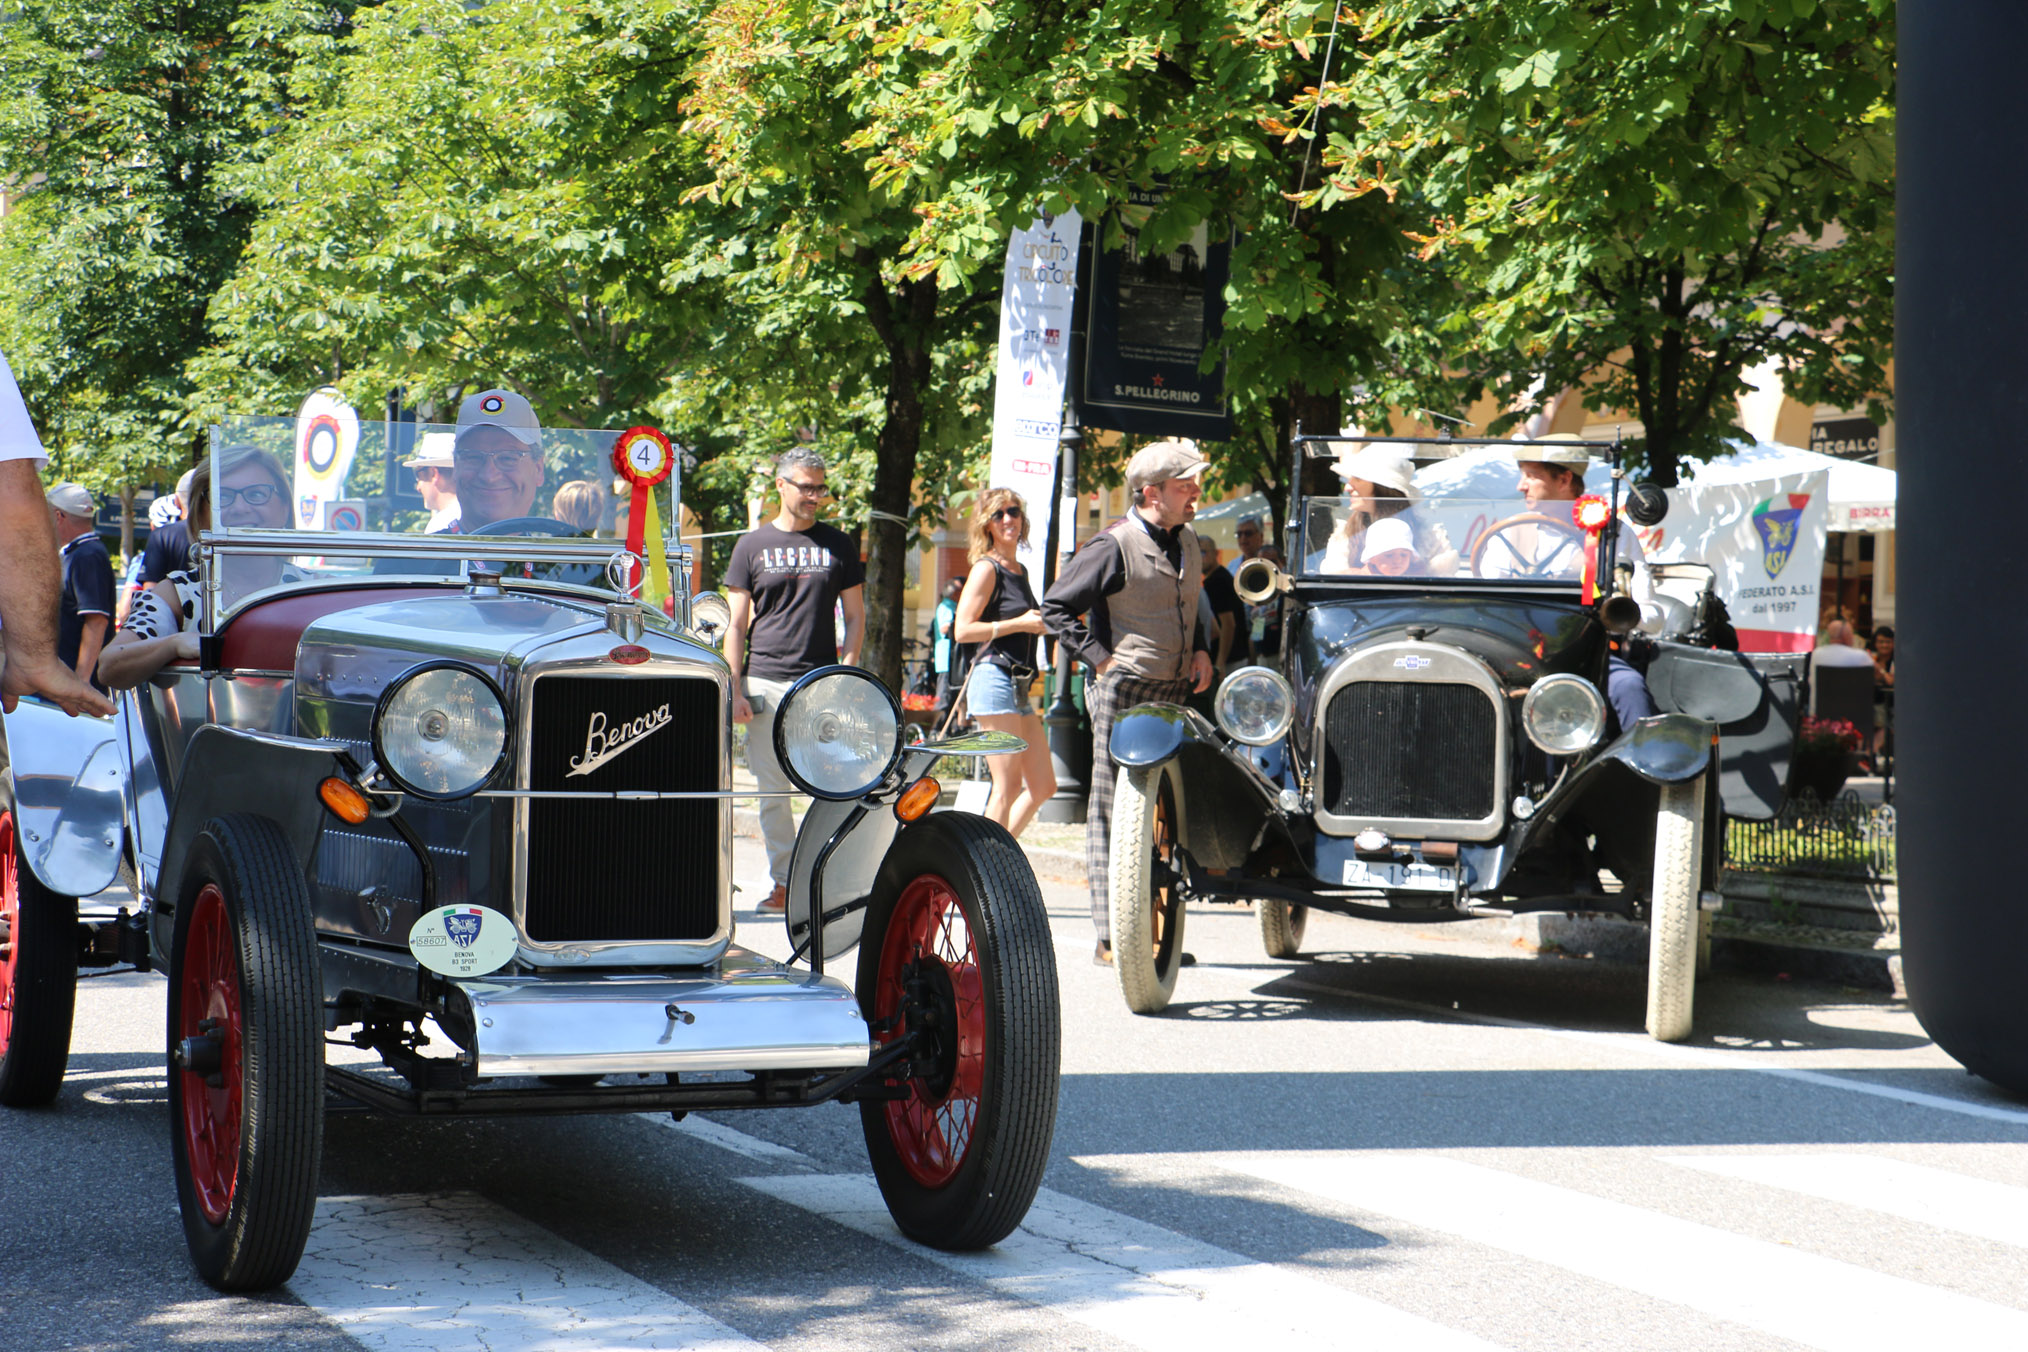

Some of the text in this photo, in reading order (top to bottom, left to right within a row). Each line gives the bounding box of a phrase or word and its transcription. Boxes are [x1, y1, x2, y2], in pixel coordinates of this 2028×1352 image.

[1812, 437, 1879, 455] REGALO
[637, 444, 651, 466] 4
[1849, 507, 1890, 519] BIRRA
[763, 546, 831, 568] LEGEND
[1737, 585, 1786, 599] FEDERATO
[1752, 601, 1797, 614] dal 1997
[568, 703, 673, 772] Benova
[417, 936, 446, 946] 58607
